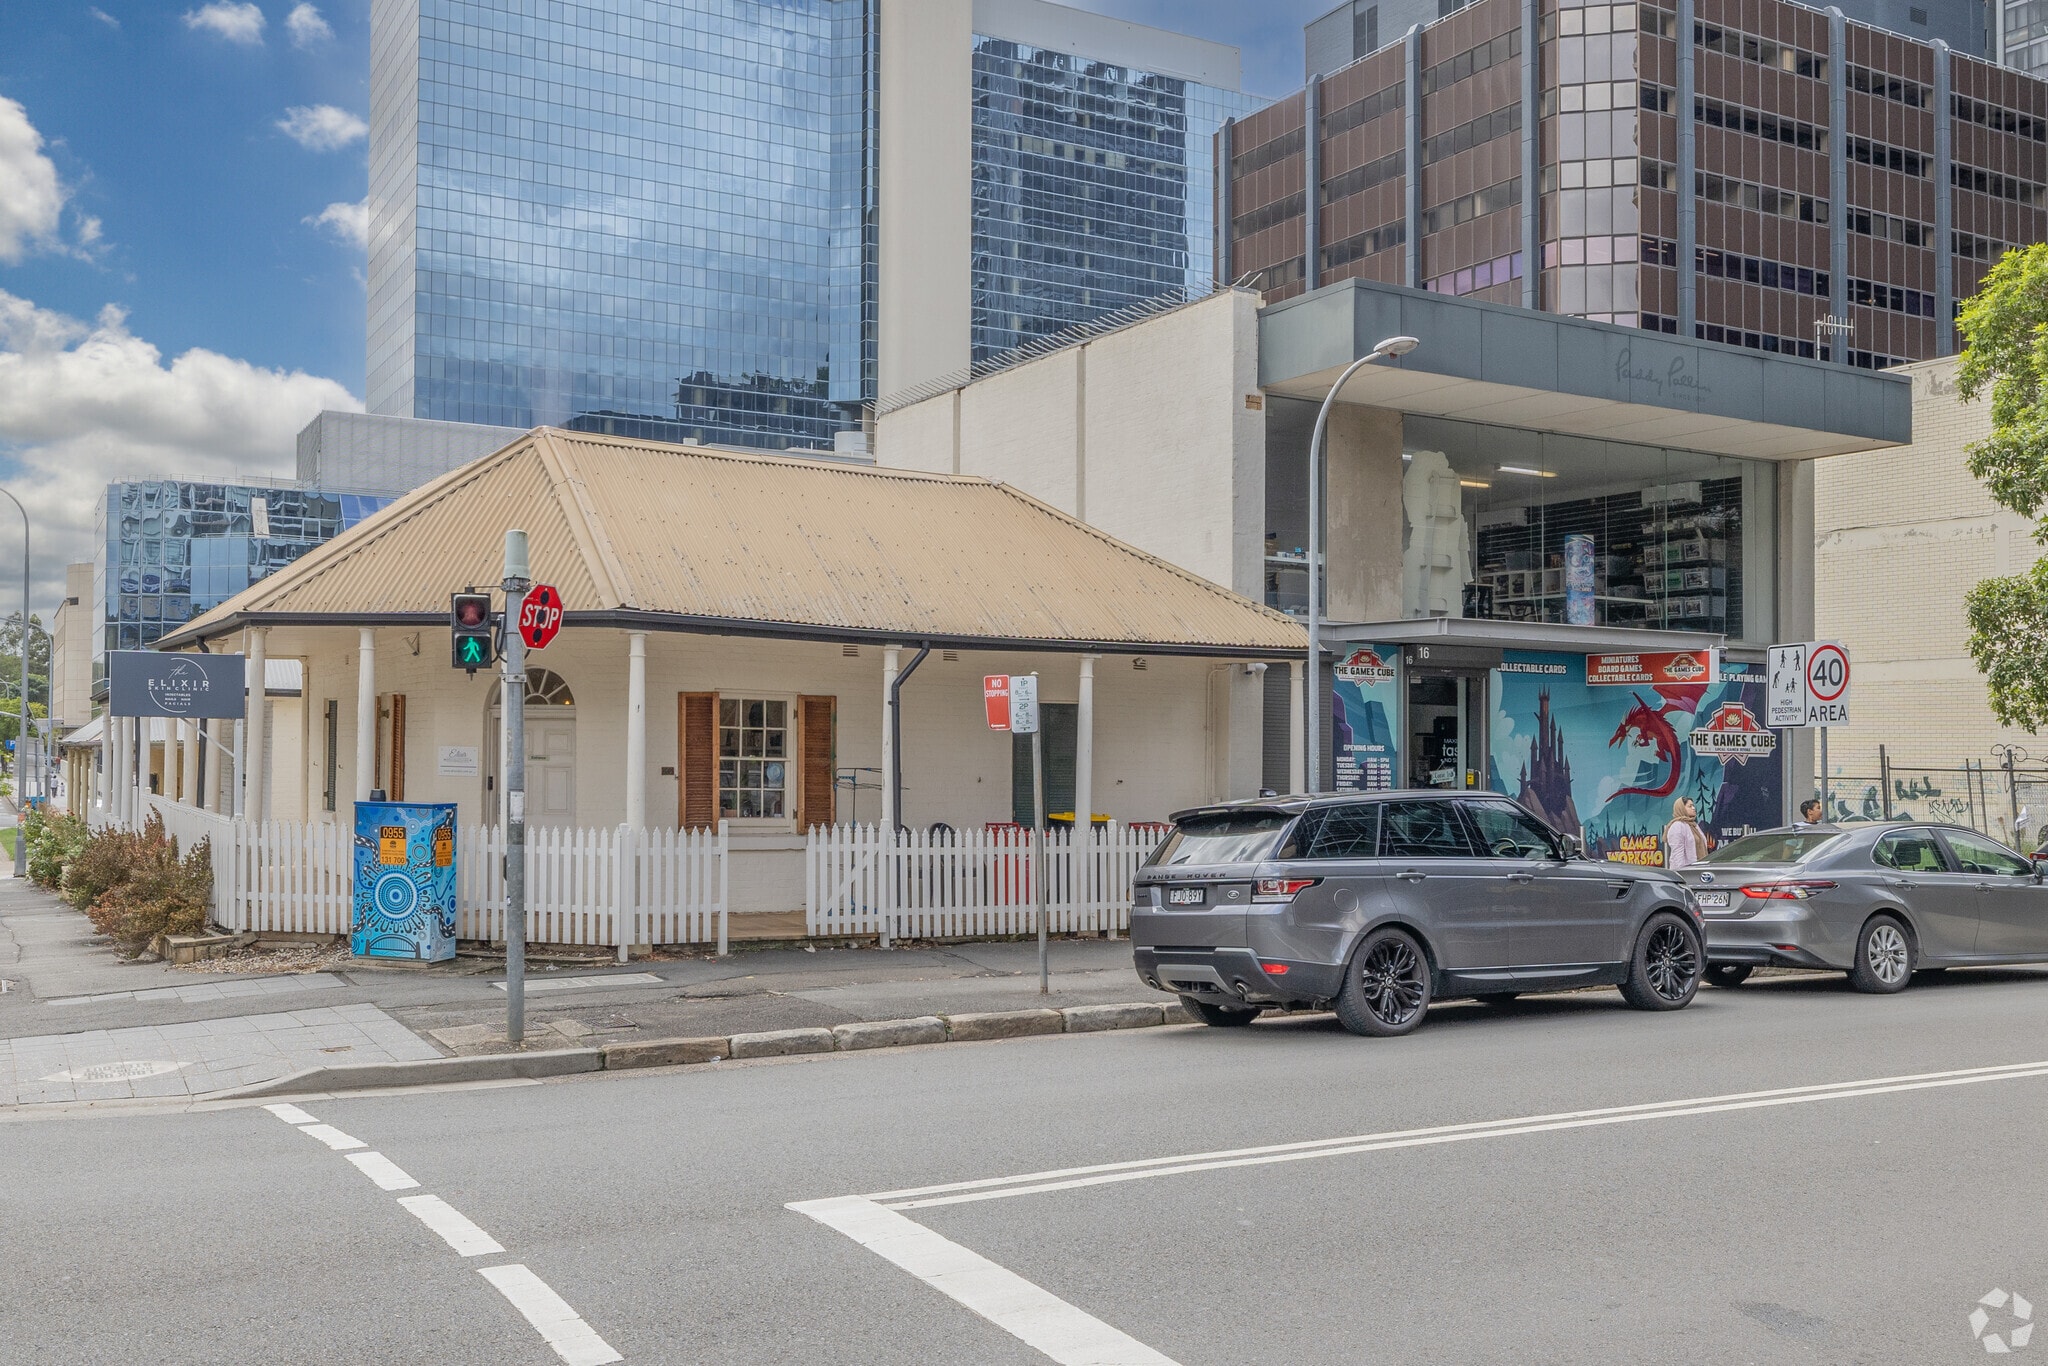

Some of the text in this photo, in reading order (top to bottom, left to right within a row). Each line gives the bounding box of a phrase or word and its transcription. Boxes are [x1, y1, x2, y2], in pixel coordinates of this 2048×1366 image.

[522, 603, 559, 630] STOP
[1418, 647, 1430, 659] 16
[1405, 656, 1413, 665] 16
[1601, 655, 1639, 664] MINIATURES
[1334, 666, 1395, 677] THE GAMES CUBE
[1544, 665, 1567, 674] CARDS
[1598, 664, 1643, 673] BOARD GAMES
[1813, 658, 1843, 687] 40
[1588, 673, 1653, 683] COLLECTABLE CARDS
[1729, 674, 1754, 683] PLAYING
[148, 679, 210, 687] ELIXIR
[992, 680, 1002, 688] NO
[1775, 714, 1798, 722] ACTIVITY
[1808, 705, 1848, 722] AREA
[1689, 733, 1776, 748] THE GAMES CUBE
[1343, 744, 1366, 752] OPENING
[382, 827, 404, 839] 0955
[437, 829, 451, 840] 0955
[1721, 827, 1732, 836] WE
[1619, 836, 1658, 851] GAMES
[394, 856, 405, 864] 700
[1606, 850, 1665, 866] WORKSHO
